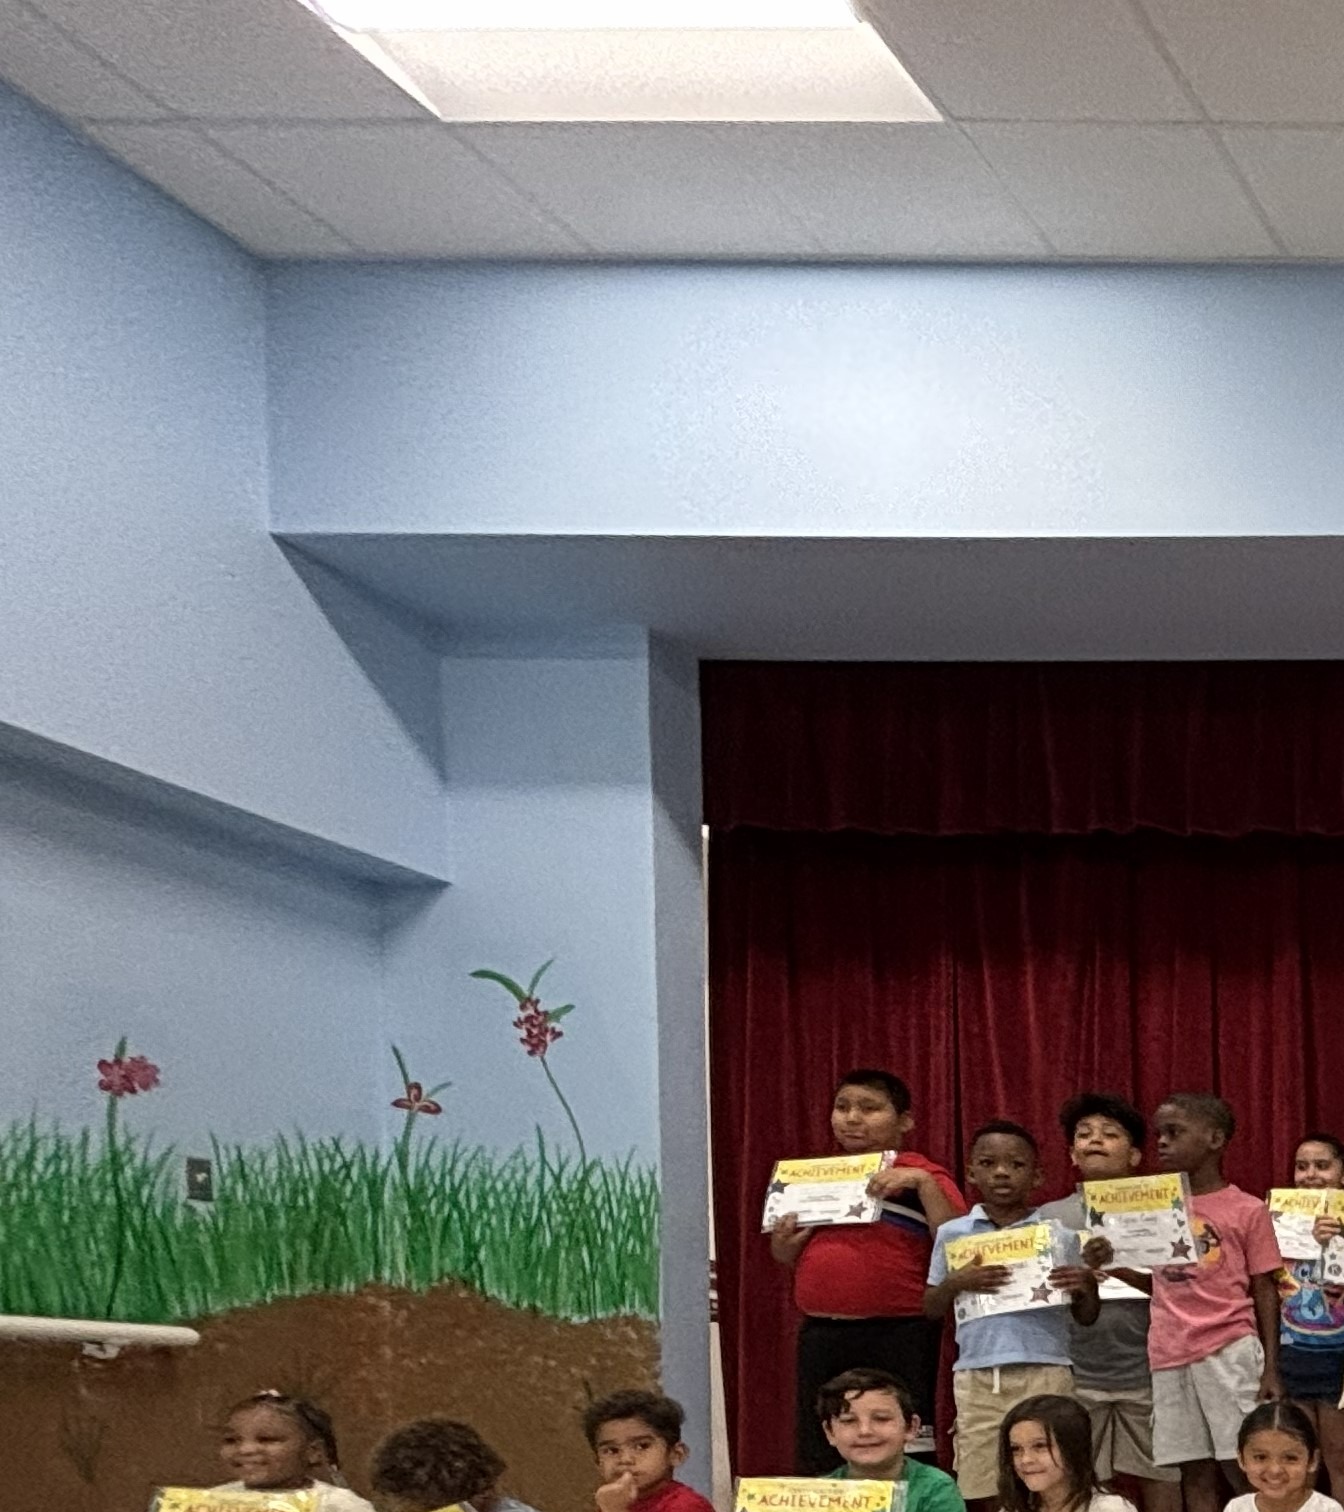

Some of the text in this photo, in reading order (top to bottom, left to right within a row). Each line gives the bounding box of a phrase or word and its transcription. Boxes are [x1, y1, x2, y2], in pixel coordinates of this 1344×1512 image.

[788, 1163, 867, 1178] ACHIEVEMENT
[1098, 1188, 1170, 1205] ACHIEVEMENT
[759, 1495, 870, 1508] ACHIEVEMENT
